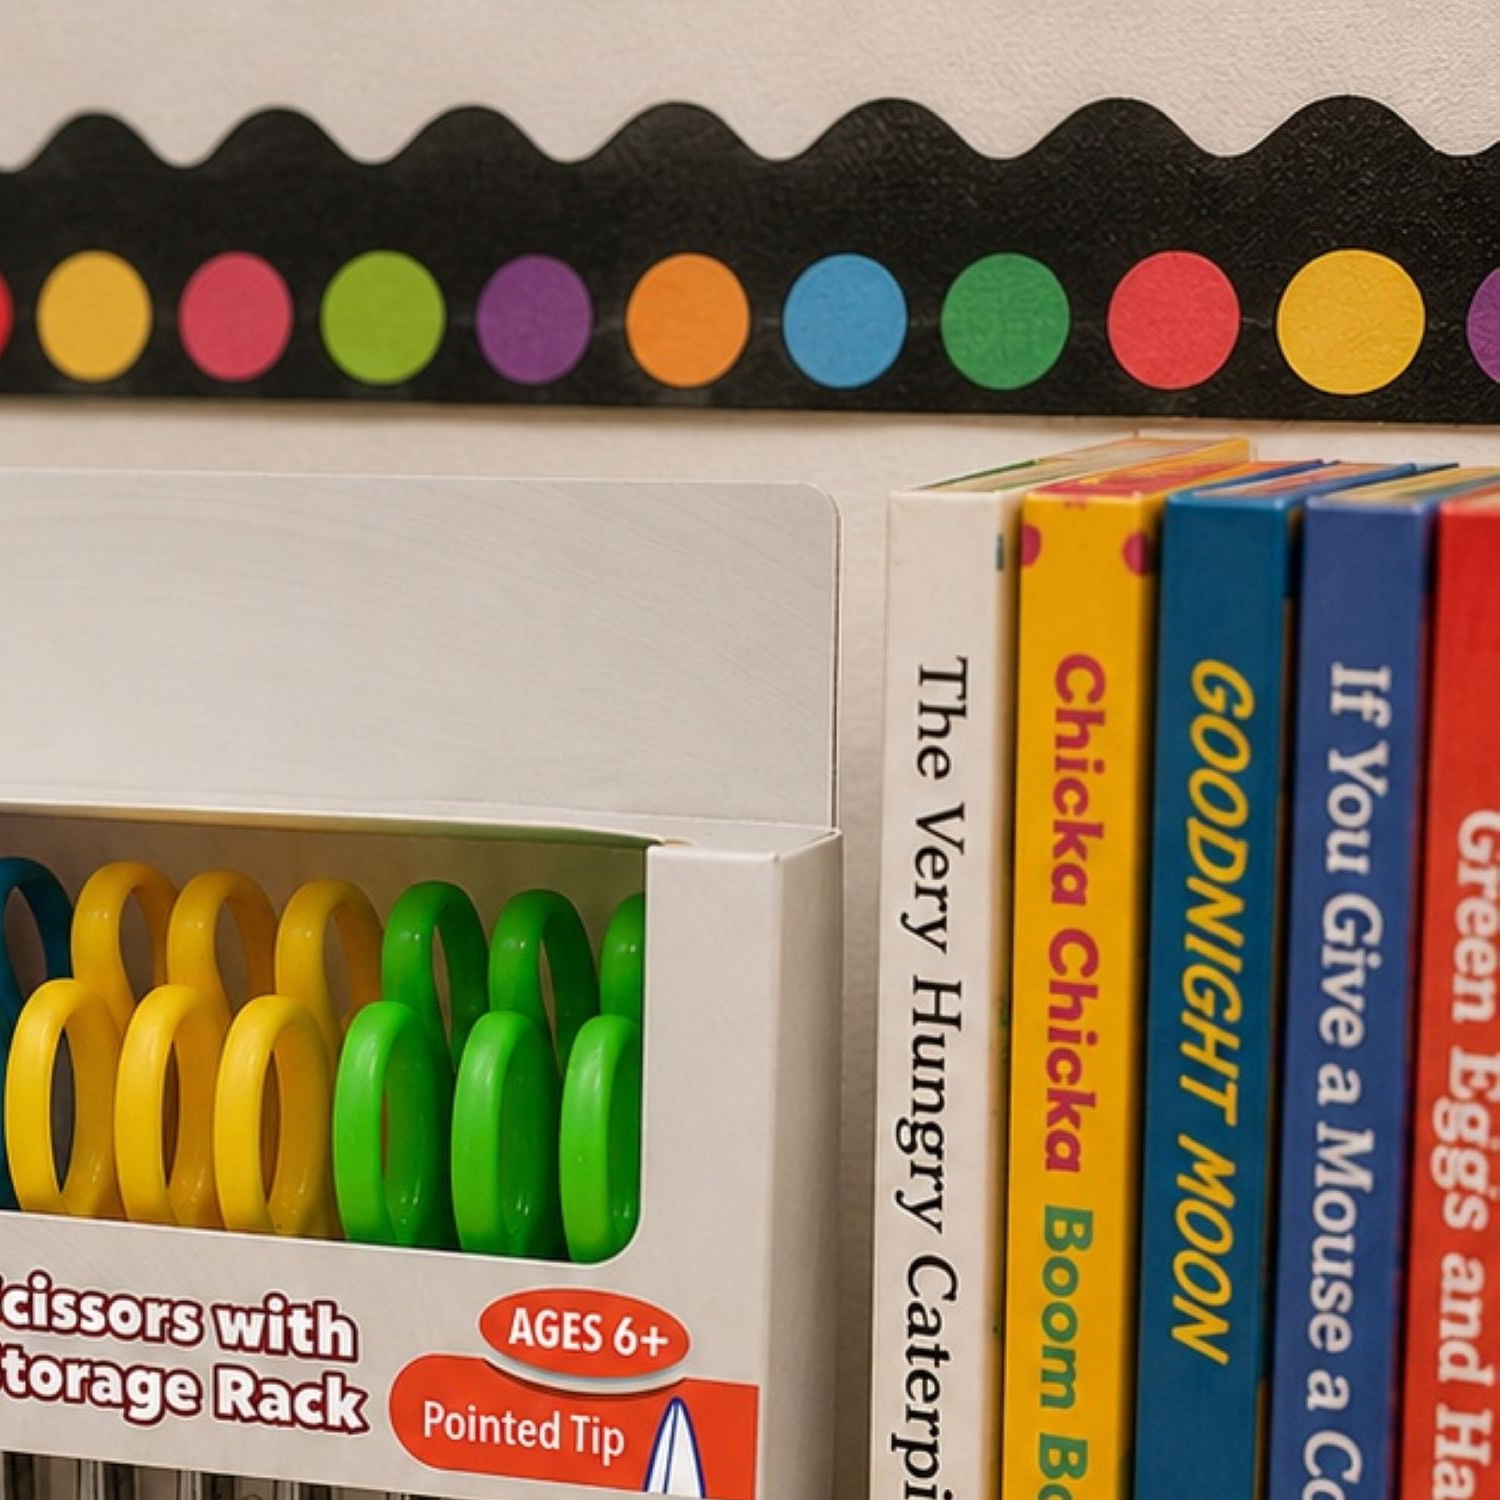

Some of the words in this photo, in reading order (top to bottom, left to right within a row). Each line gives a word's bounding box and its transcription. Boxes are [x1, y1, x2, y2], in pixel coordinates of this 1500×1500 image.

[916, 657, 968, 781] The
[1330, 662, 1392, 729] If
[1050, 653, 1107, 907] Chicka
[900, 800, 966, 956] Very
[1178, 658, 1256, 1128] GOODNIGHT
[1451, 809, 1500, 1023] Green
[1318, 892, 1383, 1050] Give
[893, 973, 963, 1236] Hungry
[1043, 927, 1100, 1174] Chicka
[1316, 1062, 1363, 1107] a
[1430, 1044, 1500, 1232] Eggs
[1038, 1203, 1094, 1411] Boom
[1170, 1133, 1237, 1367] MOON
[1308, 1120, 1374, 1355] Mouse
[210, 1293, 360, 1362] with
[508, 1307, 603, 1353] AGES
[613, 1316, 669, 1357] 6+
[1306, 1368, 1351, 1412] a
[1437, 1252, 1496, 1386] and
[211, 1363, 370, 1435] Rack
[423, 1400, 561, 1451] Pointed
[570, 1413, 625, 1467] Tip
